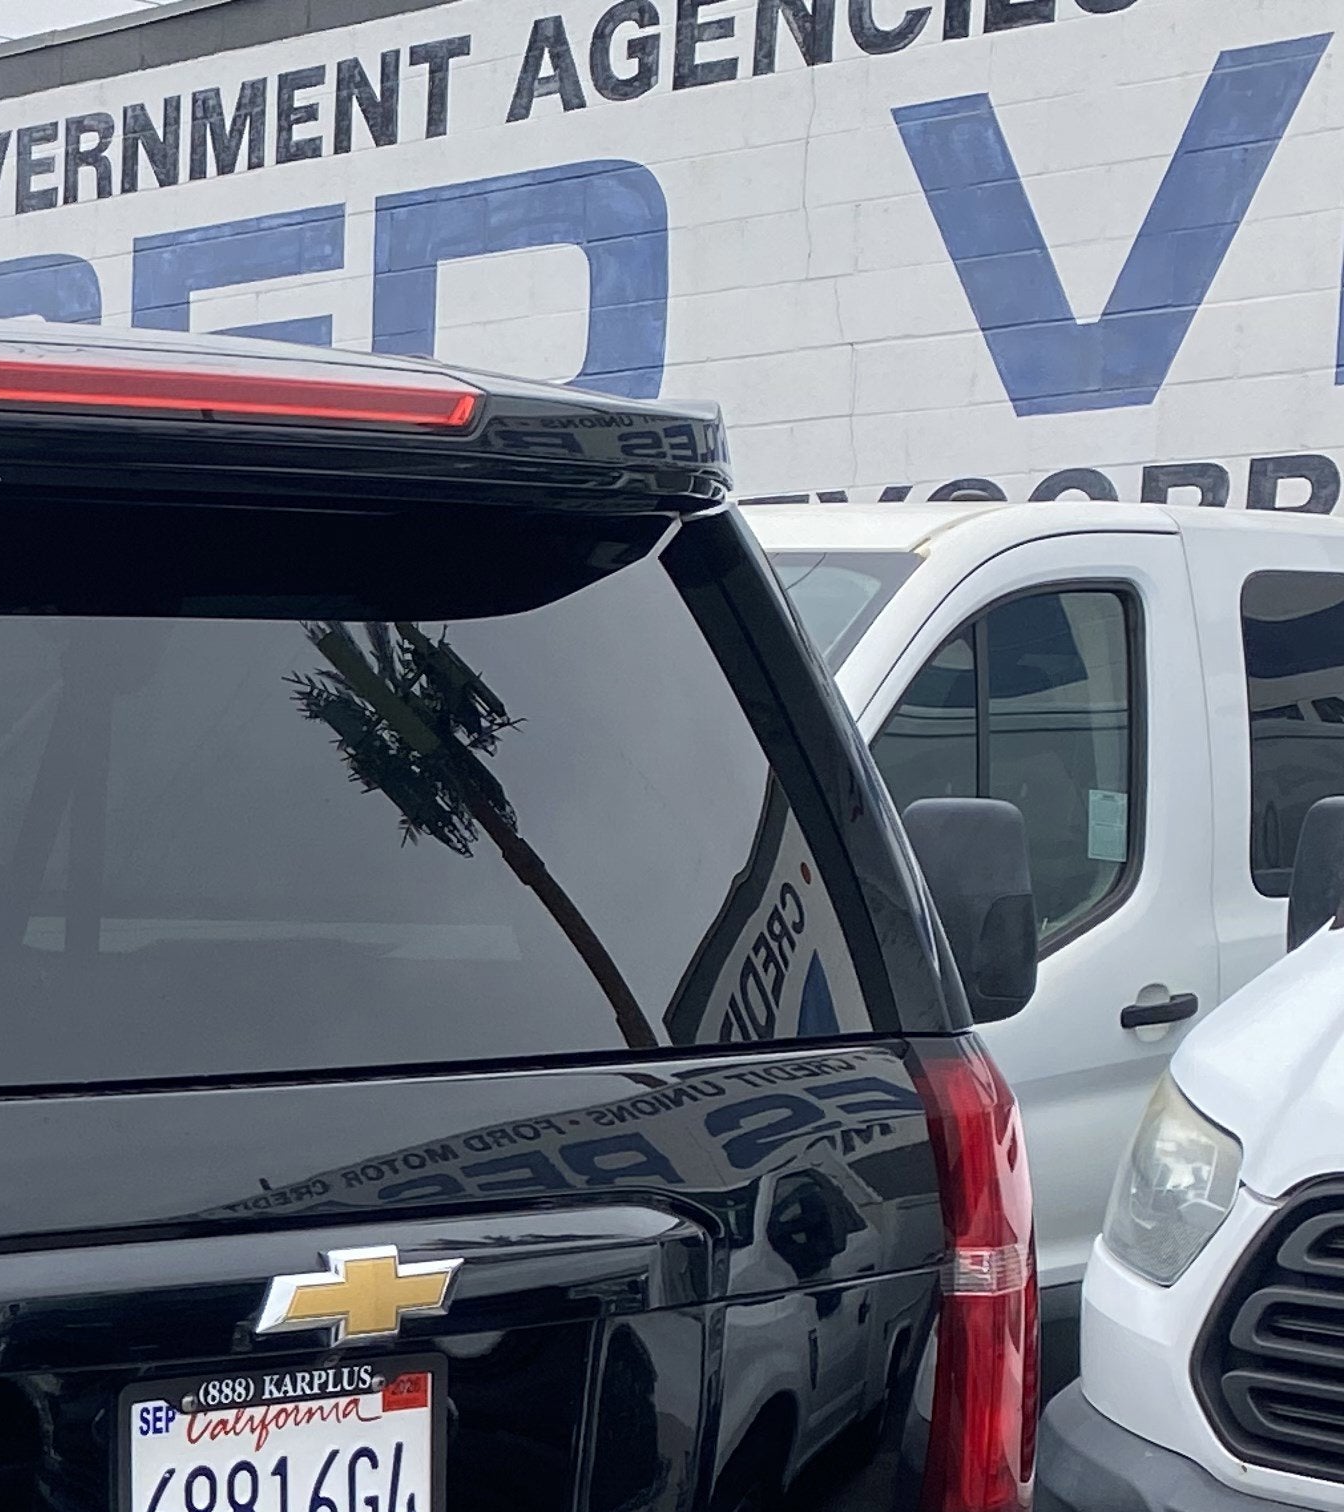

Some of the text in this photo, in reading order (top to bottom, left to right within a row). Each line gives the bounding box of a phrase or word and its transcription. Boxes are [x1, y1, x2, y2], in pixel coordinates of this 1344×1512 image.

[198, 1364, 373, 1407] (888) KARPLUS
[139, 1406, 177, 1436] SEP
[185, 1397, 384, 1452] California
